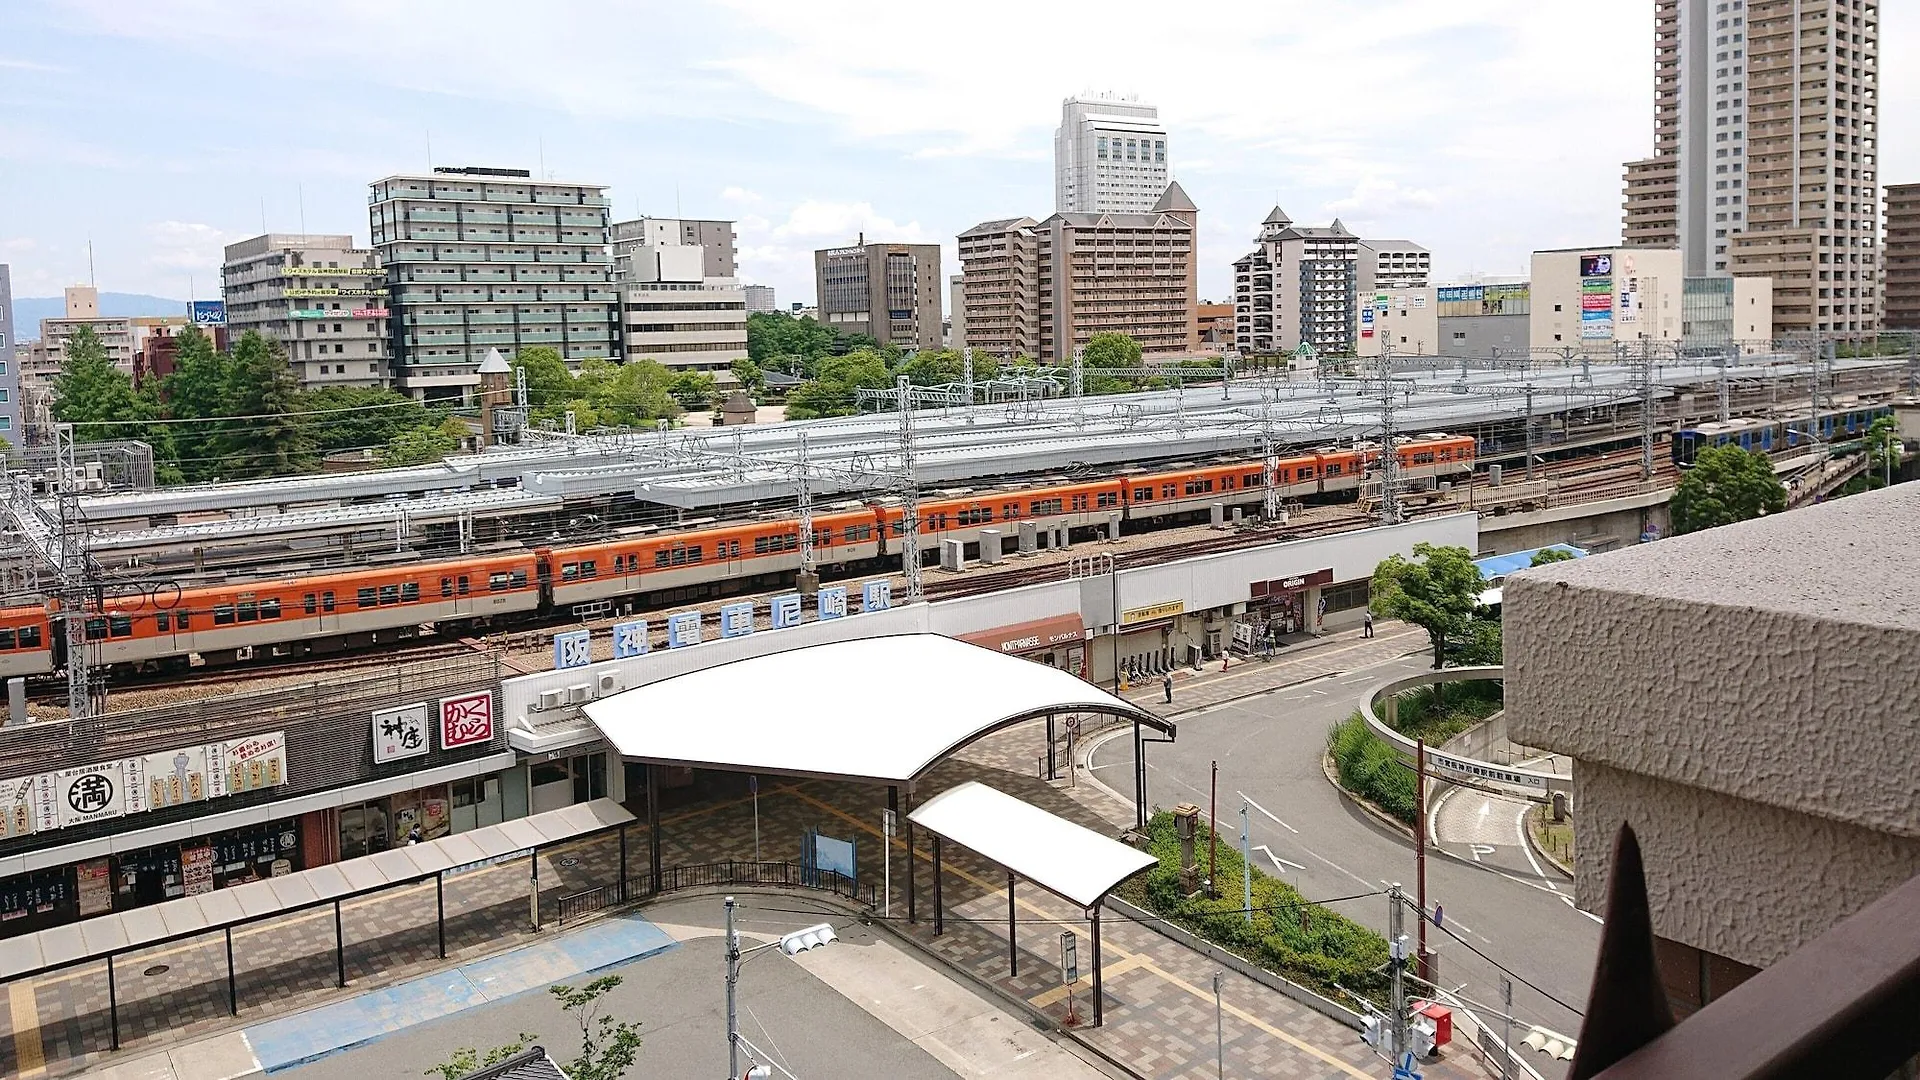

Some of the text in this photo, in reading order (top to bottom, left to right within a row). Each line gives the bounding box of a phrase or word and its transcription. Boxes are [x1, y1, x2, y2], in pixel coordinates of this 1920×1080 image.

[1283, 577, 1305, 588] ORIGIN
[561, 580, 891, 666] 阪神電車尼崎駅
[1001, 636, 1040, 652] MONTPARNASSE
[1437, 757, 1540, 785] 市営阪神尼崎駅前駐車場 入口
[71, 775, 107, 810] 満
[83, 810, 118, 823] MANMARU
